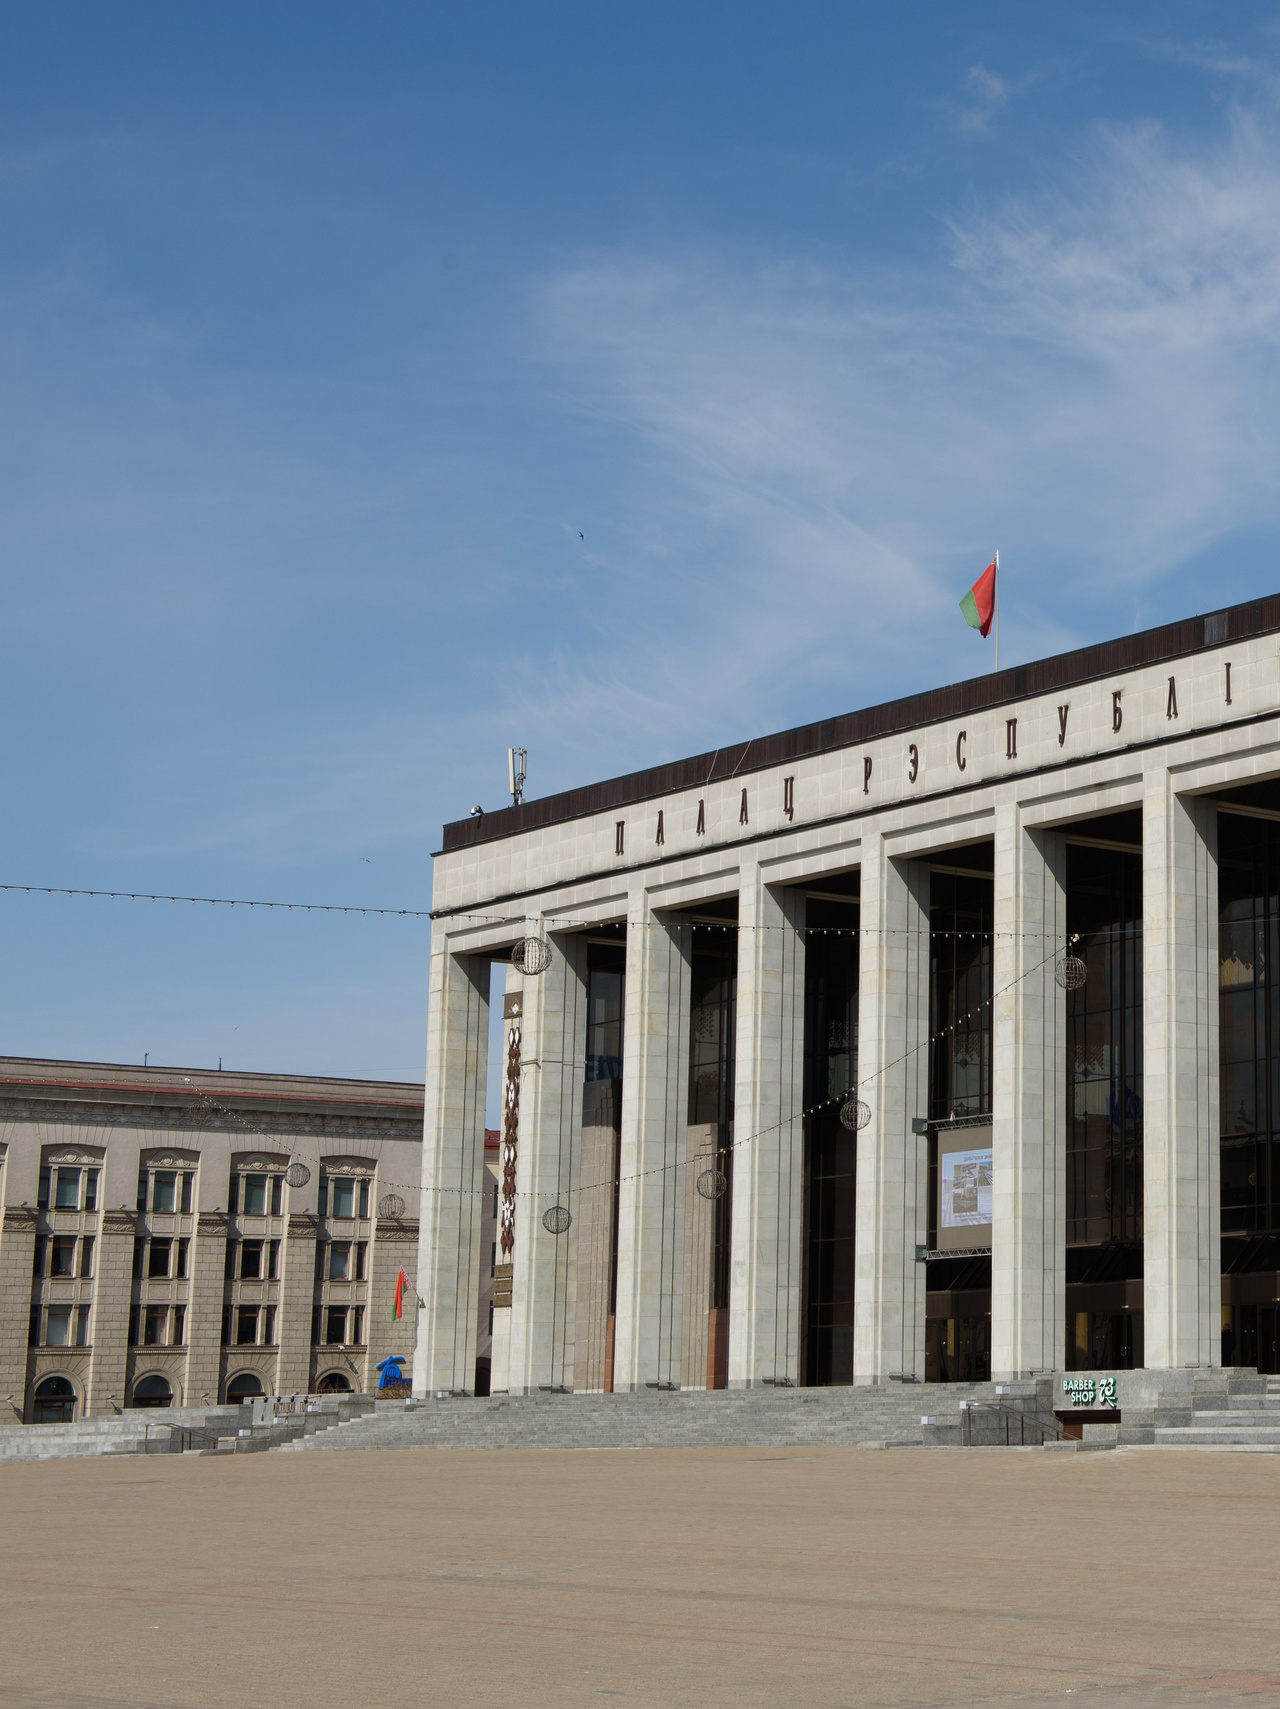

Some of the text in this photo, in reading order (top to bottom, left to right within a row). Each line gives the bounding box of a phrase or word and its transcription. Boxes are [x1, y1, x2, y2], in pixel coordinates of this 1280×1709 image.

[615, 776, 796, 855] ПАЛАЦ
[1063, 1379, 1095, 1391] BARBER
[1071, 1391, 1095, 1403] SHOP
